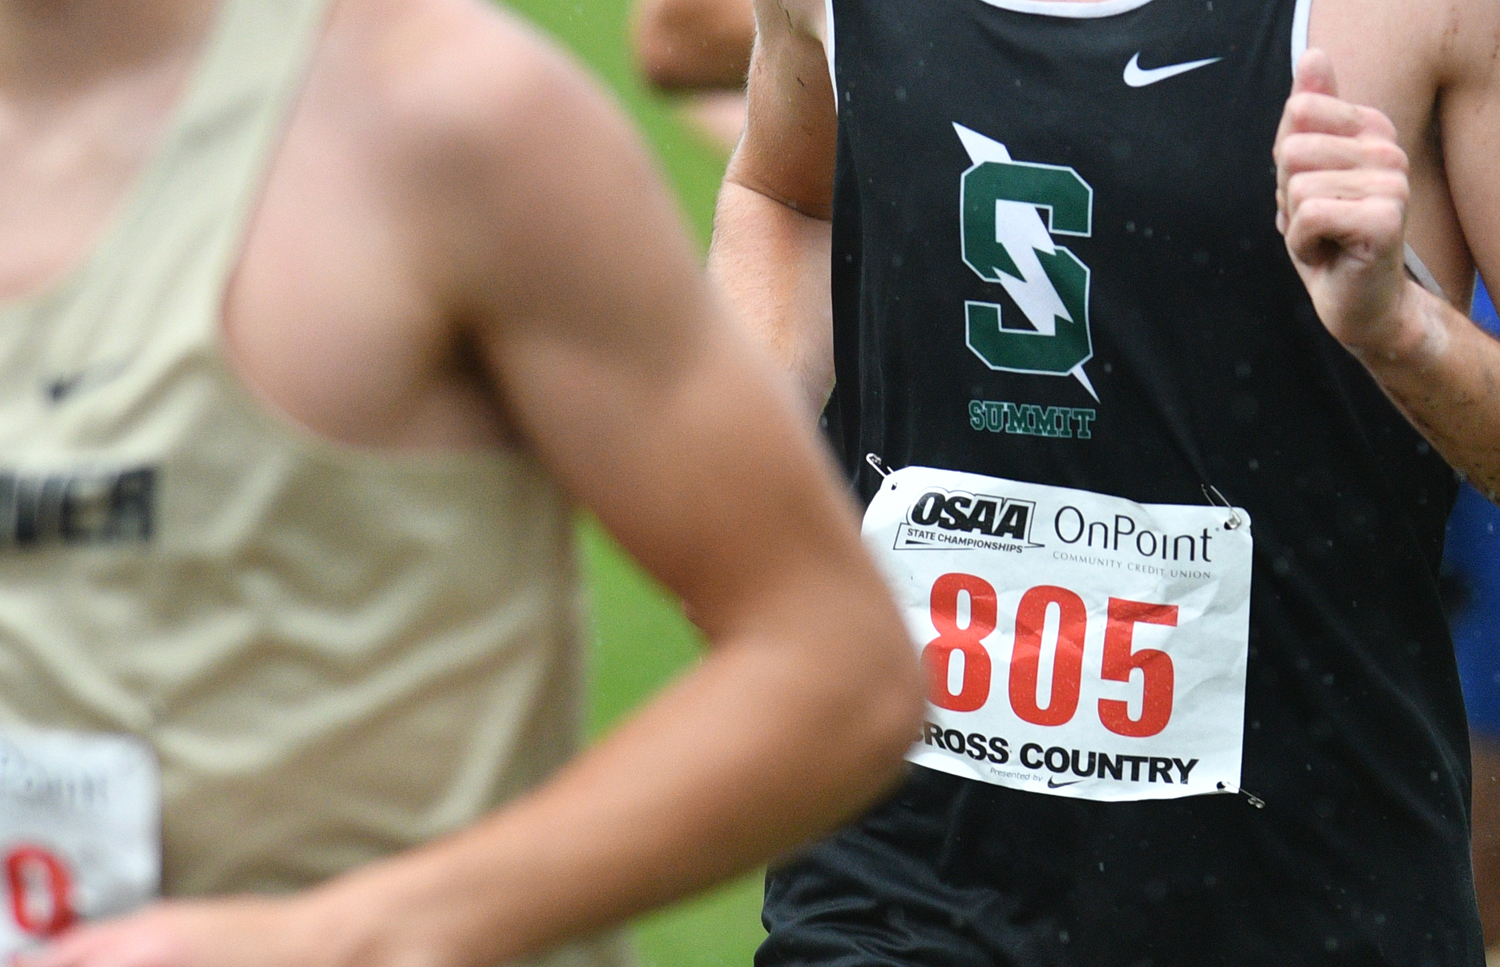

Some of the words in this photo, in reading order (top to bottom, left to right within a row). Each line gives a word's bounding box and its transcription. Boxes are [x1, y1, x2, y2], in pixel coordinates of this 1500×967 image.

[960, 159, 1093, 376] S
[968, 399, 1096, 439] SUMMIT
[906, 527, 940, 541] STATE
[937, 532, 1024, 554] CHAMPIONSHIPS
[910, 491, 1031, 541] OSAA
[1054, 505, 1213, 563] OnPoint
[1052, 550, 1123, 569] COMMUNITY
[1127, 562, 1166, 577] CREDIT
[1170, 569, 1212, 580] UNION
[921, 572, 1180, 738] 805
[918, 721, 1010, 765] ROSS
[1019, 742, 1200, 785] COUNTRY
[989, 766, 1030, 781] Presented
